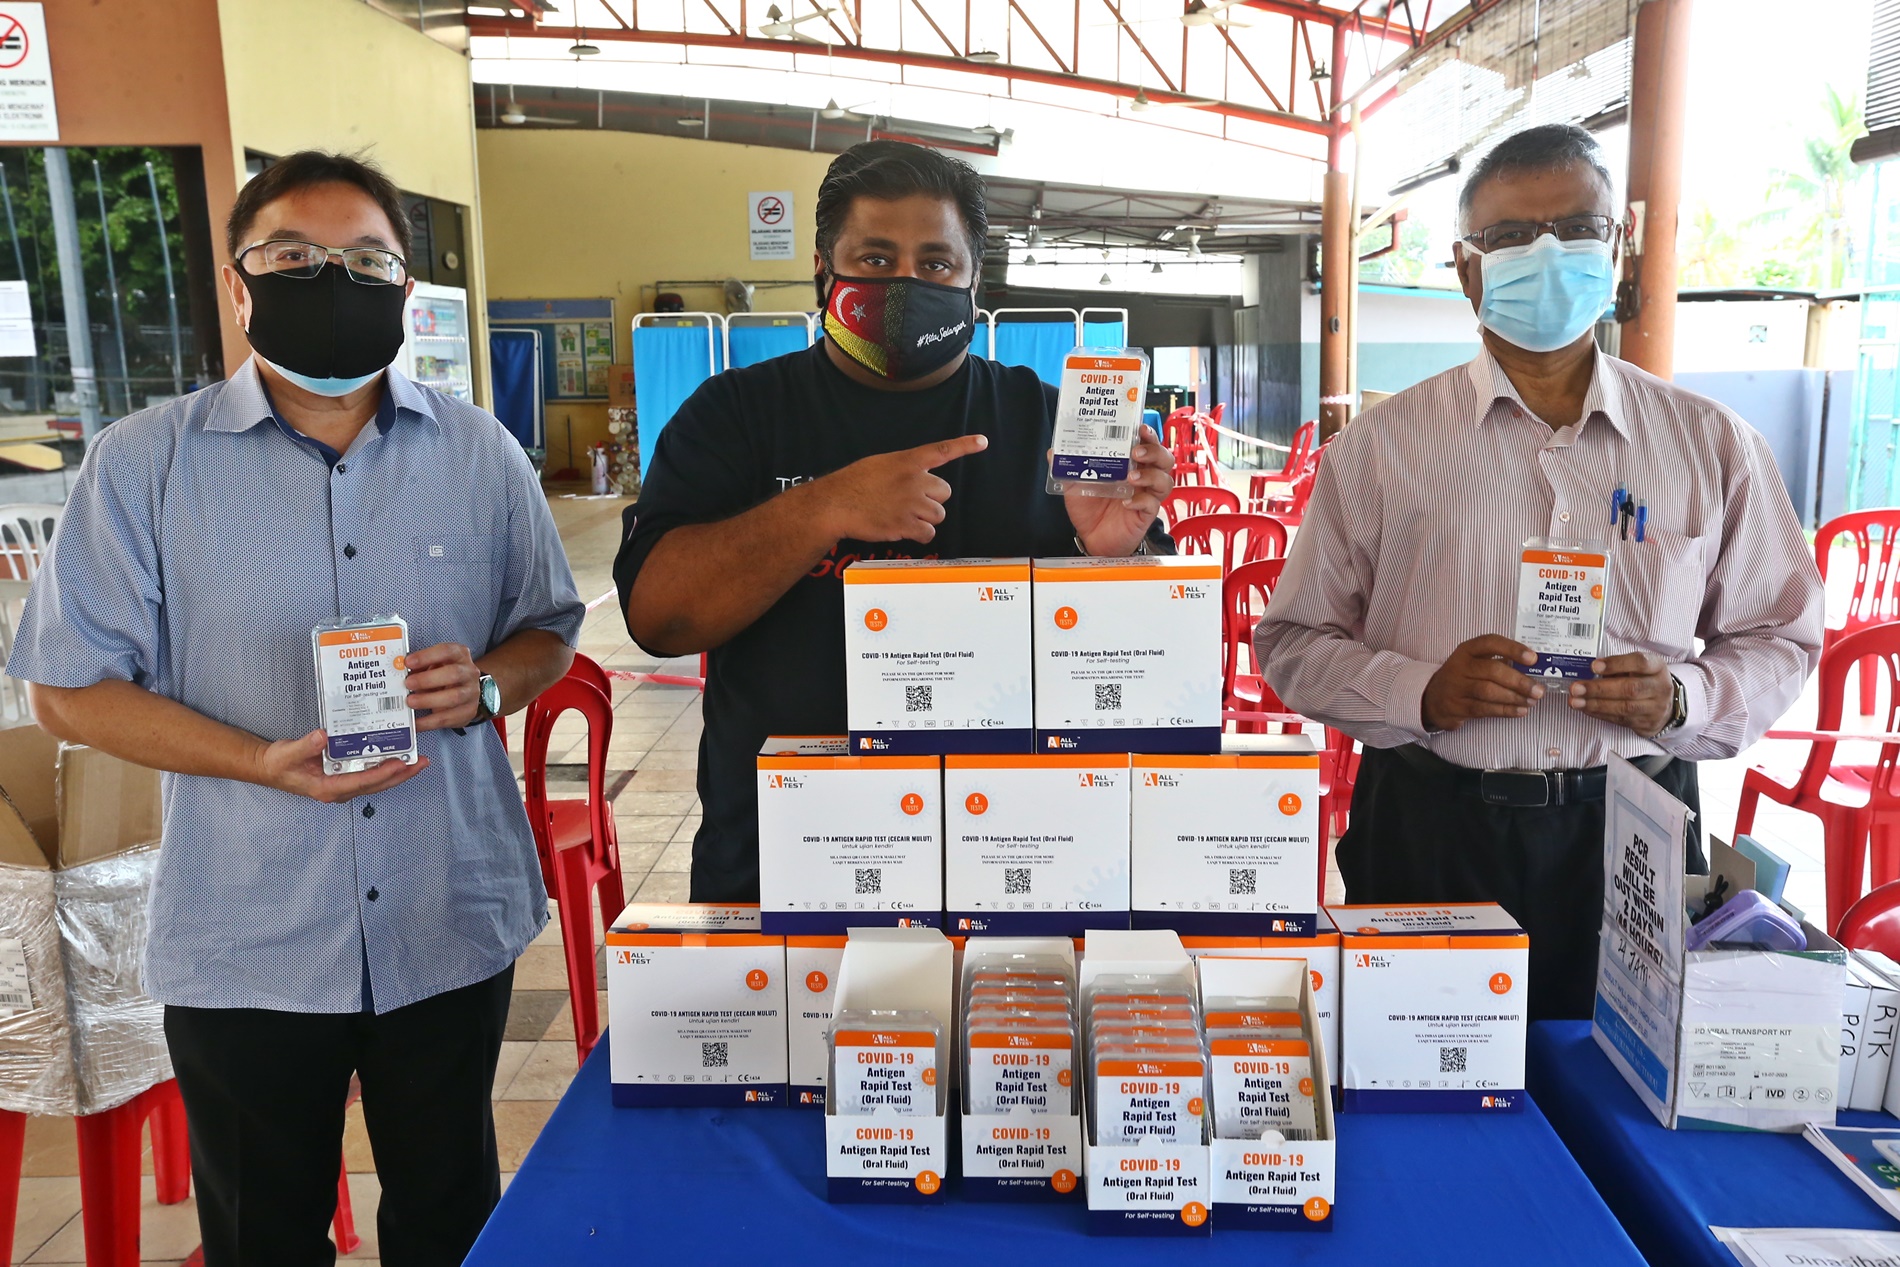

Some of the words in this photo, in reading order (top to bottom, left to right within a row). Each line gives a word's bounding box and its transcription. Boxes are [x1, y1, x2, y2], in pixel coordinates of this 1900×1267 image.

[1081, 374, 1124, 384] COVID-19
[1086, 386, 1115, 395] Antigen
[1080, 397, 1101, 406] Rapid
[1103, 398, 1118, 406] Test
[1079, 408, 1095, 416] (Oral
[1097, 409, 1116, 417] Fluid)
[1539, 569, 1586, 581] COVID-19
[1545, 582, 1577, 591] Antigen
[1539, 592, 1562, 602] Rapid
[1564, 594, 1581, 603] Test
[1538, 604, 1557, 613] (Oral
[1559, 605, 1580, 614] Fluid)
[339, 645, 386, 659] COVID-19
[348, 661, 379, 670] Antigen
[343, 672, 367, 682] Rapid
[368, 670, 386, 678] Test
[345, 683, 364, 693] (Oral
[365, 682, 386, 691] Fluid)
[1633, 833, 1648, 861] PCR
[1625, 846, 1656, 886] RESULT
[1623, 863, 1641, 894] WILL
[1643, 882, 1655, 906] BE
[1614, 874, 1631, 896] OUT
[1633, 890, 1664, 933] WITHIN
[1624, 899, 1629, 916] 2
[1630, 905, 1654, 938] DAYS
[1840, 1014, 1859, 1056] PCR
[1868, 1005, 1898, 1058] RTK
[1234, 1062, 1290, 1074] COVID-19
[1244, 1078, 1282, 1089] Antigen
[1238, 1092, 1266, 1103] Rapid
[1269, 1092, 1290, 1102] Test
[1766, 1089, 1784, 1098] IVD
[1241, 1107, 1262, 1117] (Oral
[1265, 1107, 1290, 1118] Fluid)
[856, 1129, 914, 1140] COVID-19
[992, 1128, 1050, 1140] COVID-19
[840, 1145, 877, 1156] Antigen
[881, 1145, 907, 1157] Rapid
[911, 1146, 930, 1155] Test
[976, 1145, 1013, 1156] Antigen
[1017, 1145, 1044, 1156] Rapid
[1047, 1145, 1067, 1154] Test
[862, 1160, 883, 1169] (Oral
[885, 1160, 909, 1169] Fluid)
[998, 1159, 1019, 1169] (Oral
[1021, 1159, 1045, 1169] Fluid)
[1120, 1159, 1180, 1171] COVID-19
[1243, 1153, 1304, 1166] COVID-19
[1226, 1170, 1265, 1182] Antigen
[1268, 1171, 1297, 1182] Rapid
[1301, 1171, 1320, 1181] Test
[1103, 1177, 1141, 1188] Antigen
[1145, 1177, 1173, 1188] Rapid
[1176, 1177, 1197, 1186] Test
[1248, 1186, 1270, 1195] (Oral
[1273, 1186, 1297, 1196] Fluid)
[1126, 1192, 1148, 1201] (Oral
[1150, 1192, 1174, 1202] Fluid)
[1259, 1206, 1298, 1214] Self-testing
[1314, 1201, 1319, 1209] 5
